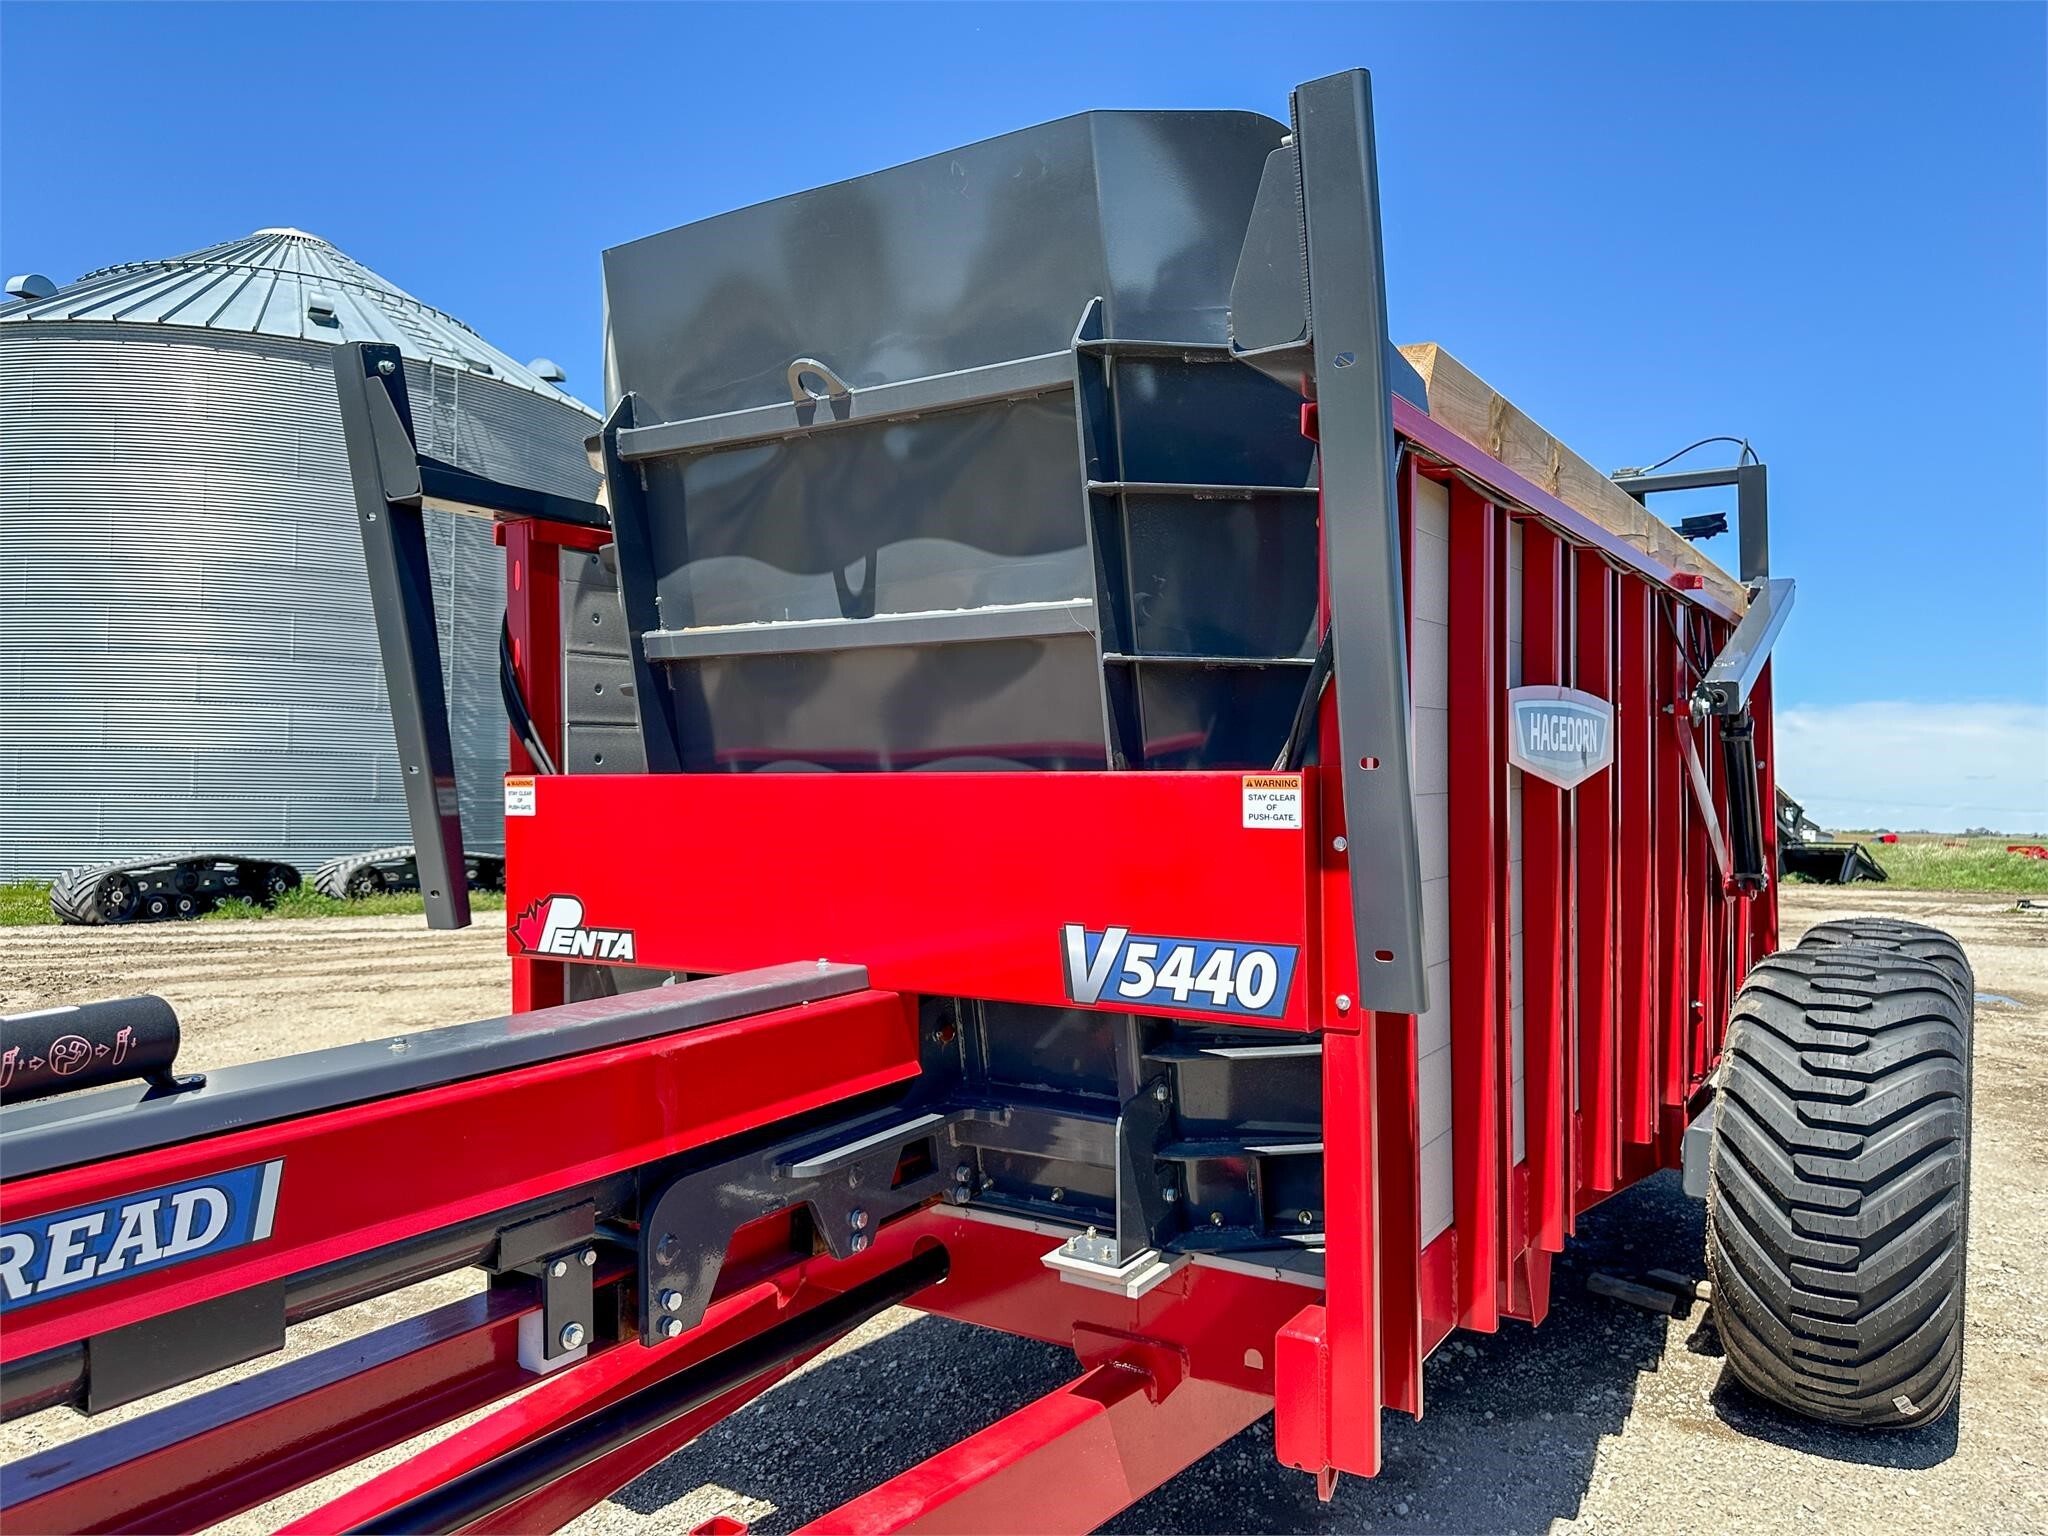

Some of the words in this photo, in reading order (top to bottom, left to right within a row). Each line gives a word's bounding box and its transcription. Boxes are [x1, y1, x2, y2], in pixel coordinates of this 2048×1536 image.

[1530, 712, 1598, 753] HAGEDORN
[1254, 779, 1298, 788] WARNING
[1269, 794, 1296, 802] CLEAR
[1248, 813, 1296, 821] PUSH-GATE.
[537, 897, 635, 960] PENTA
[1064, 924, 1278, 1010] V5440
